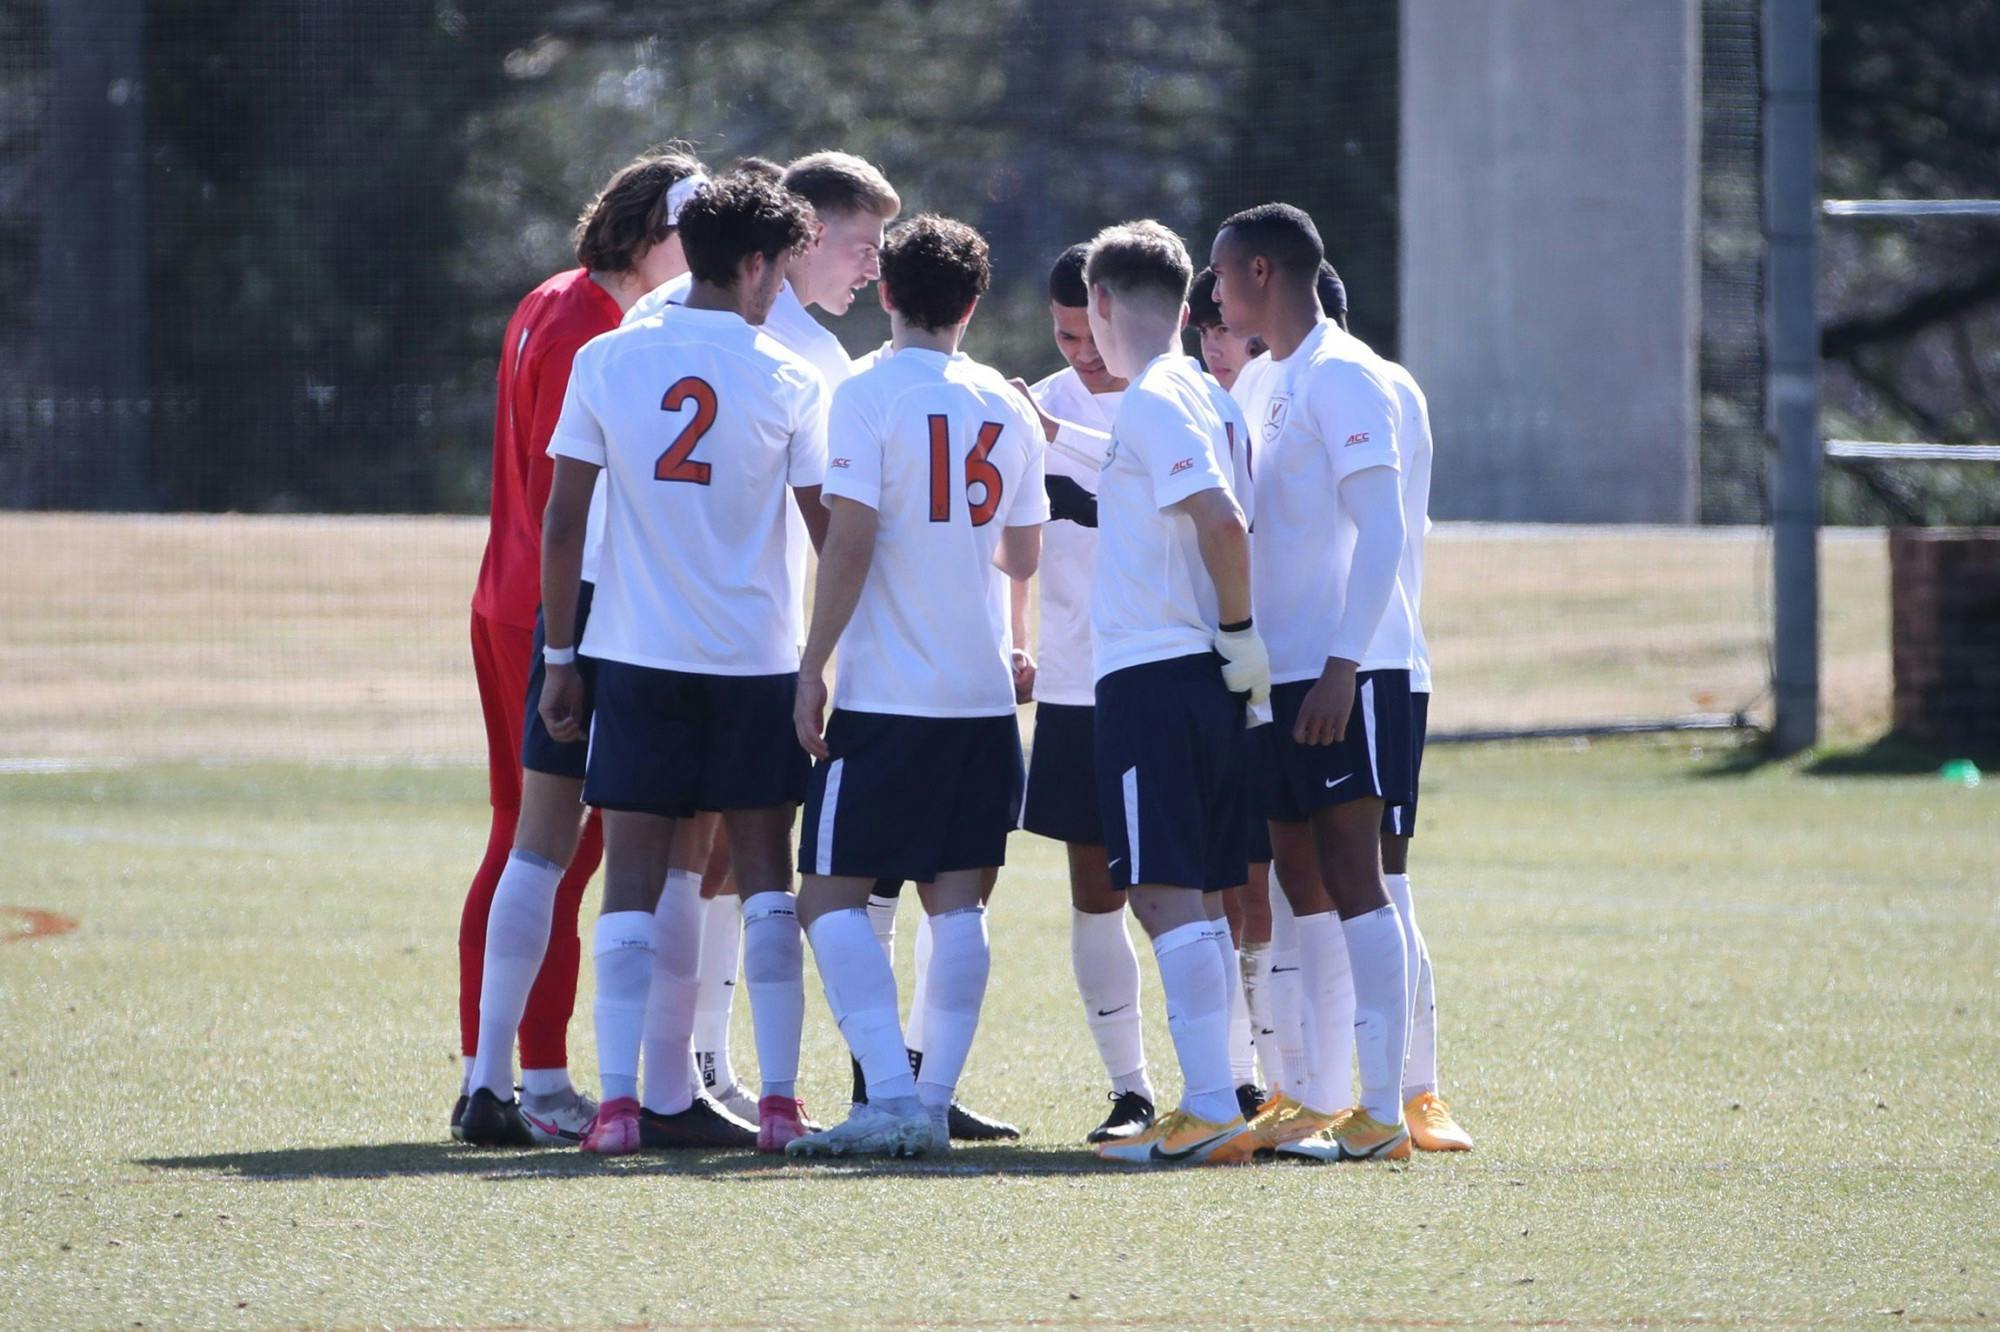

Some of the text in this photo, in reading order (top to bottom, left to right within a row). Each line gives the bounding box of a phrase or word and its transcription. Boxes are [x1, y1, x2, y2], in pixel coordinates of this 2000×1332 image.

[653, 376, 718, 486] 2
[1343, 432, 1370, 448] ACC
[927, 413, 1005, 527] 16
[1169, 457, 1194, 476] ACC
